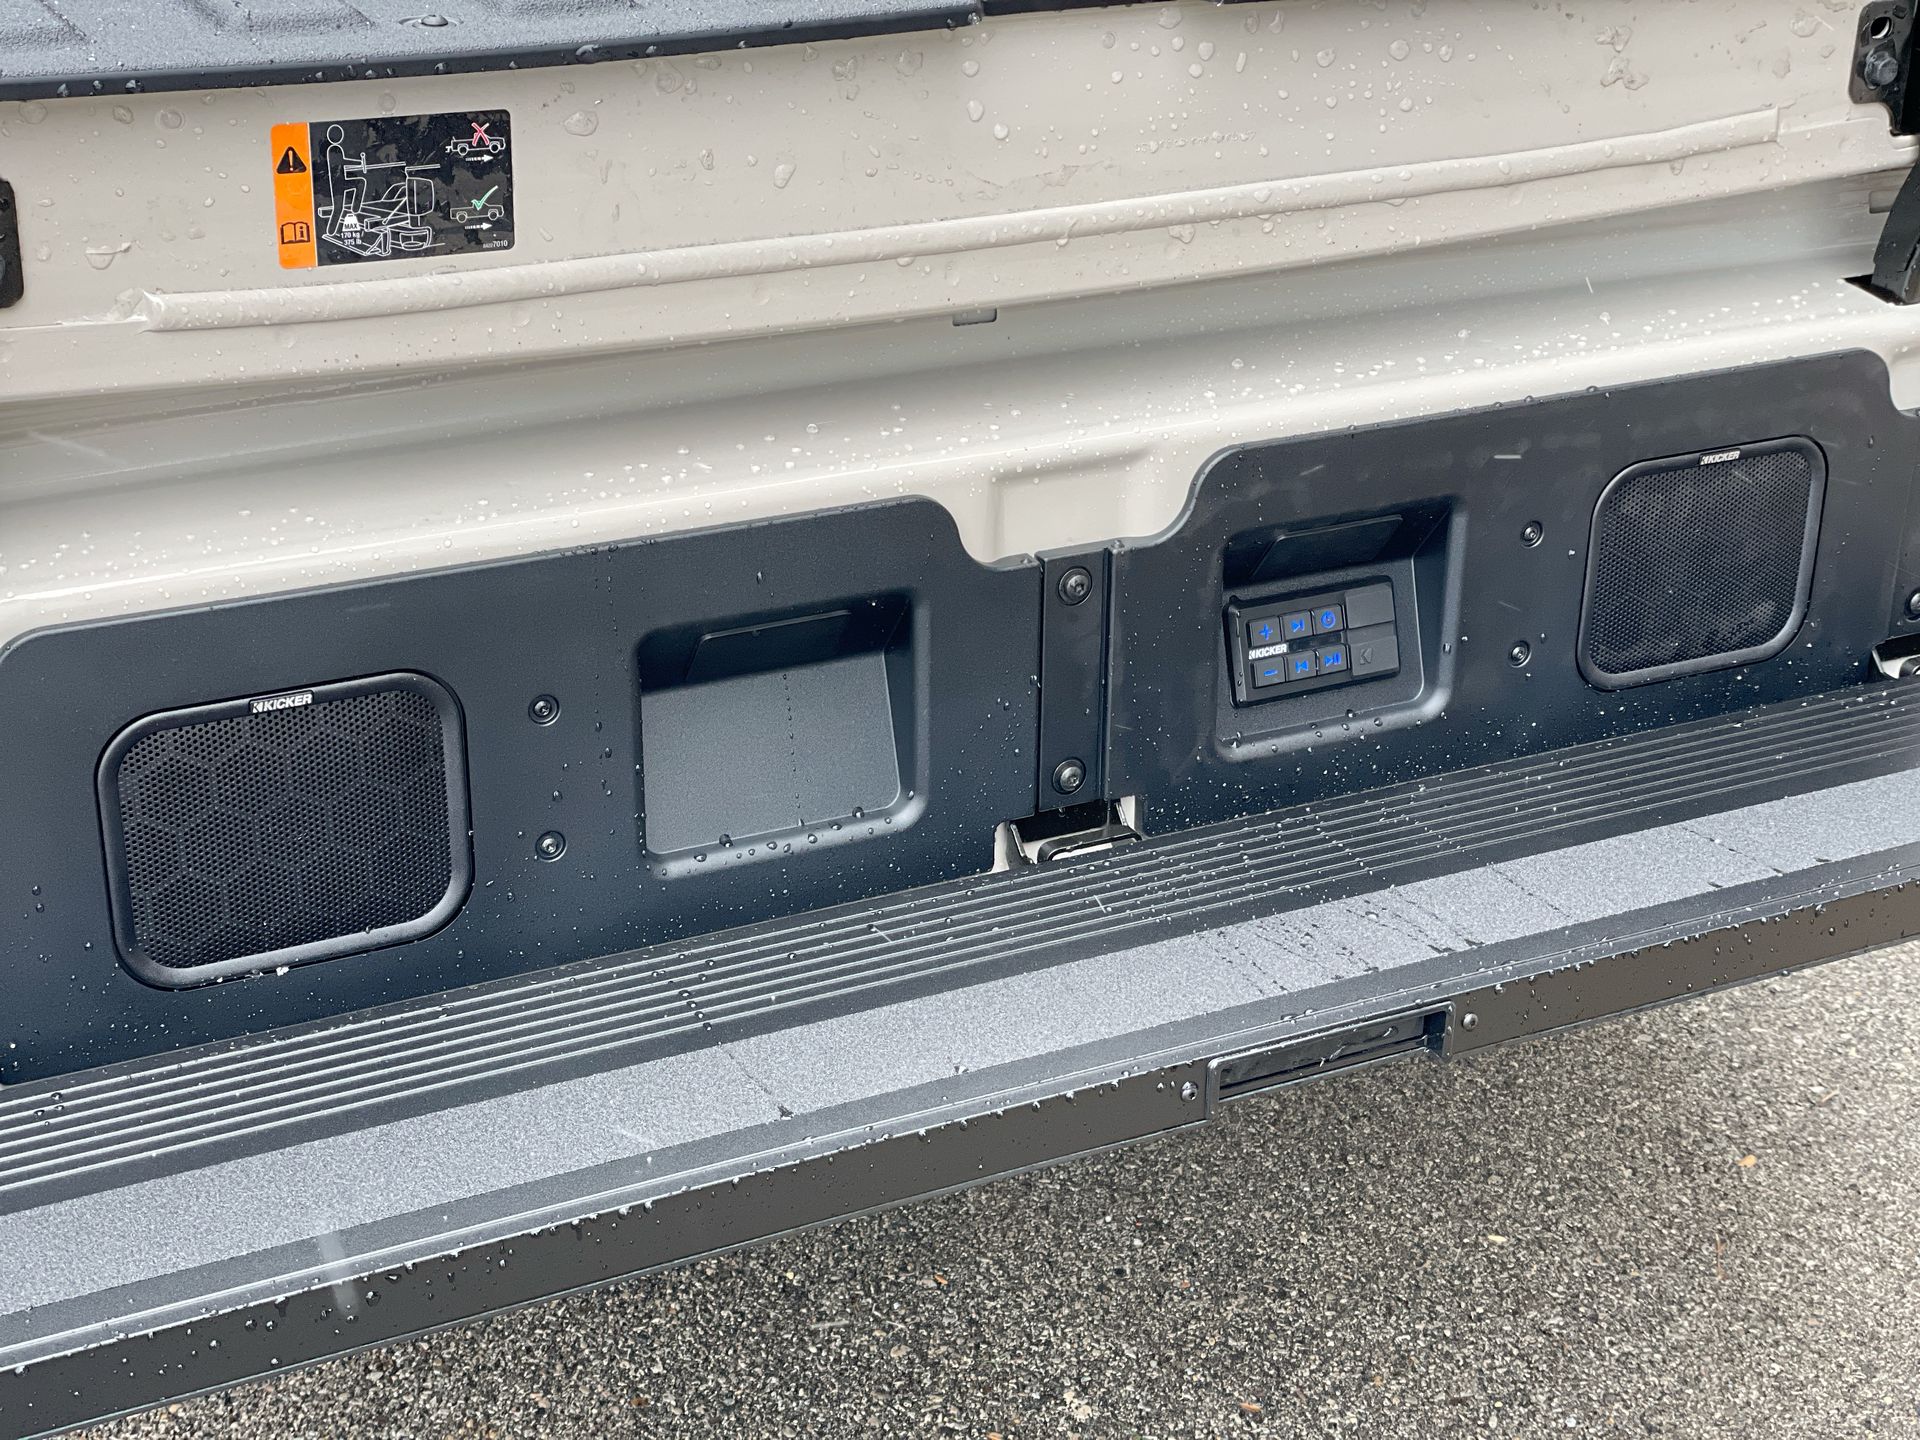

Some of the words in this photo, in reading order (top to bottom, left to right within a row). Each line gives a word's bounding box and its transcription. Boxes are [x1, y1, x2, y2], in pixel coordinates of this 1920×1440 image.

[341, 231, 351, 239] 170
[352, 231, 361, 239] kg
[1708, 450, 1741, 464] KICKER
[1255, 643, 1287, 659] KICKER
[263, 693, 312, 712] KICKER
